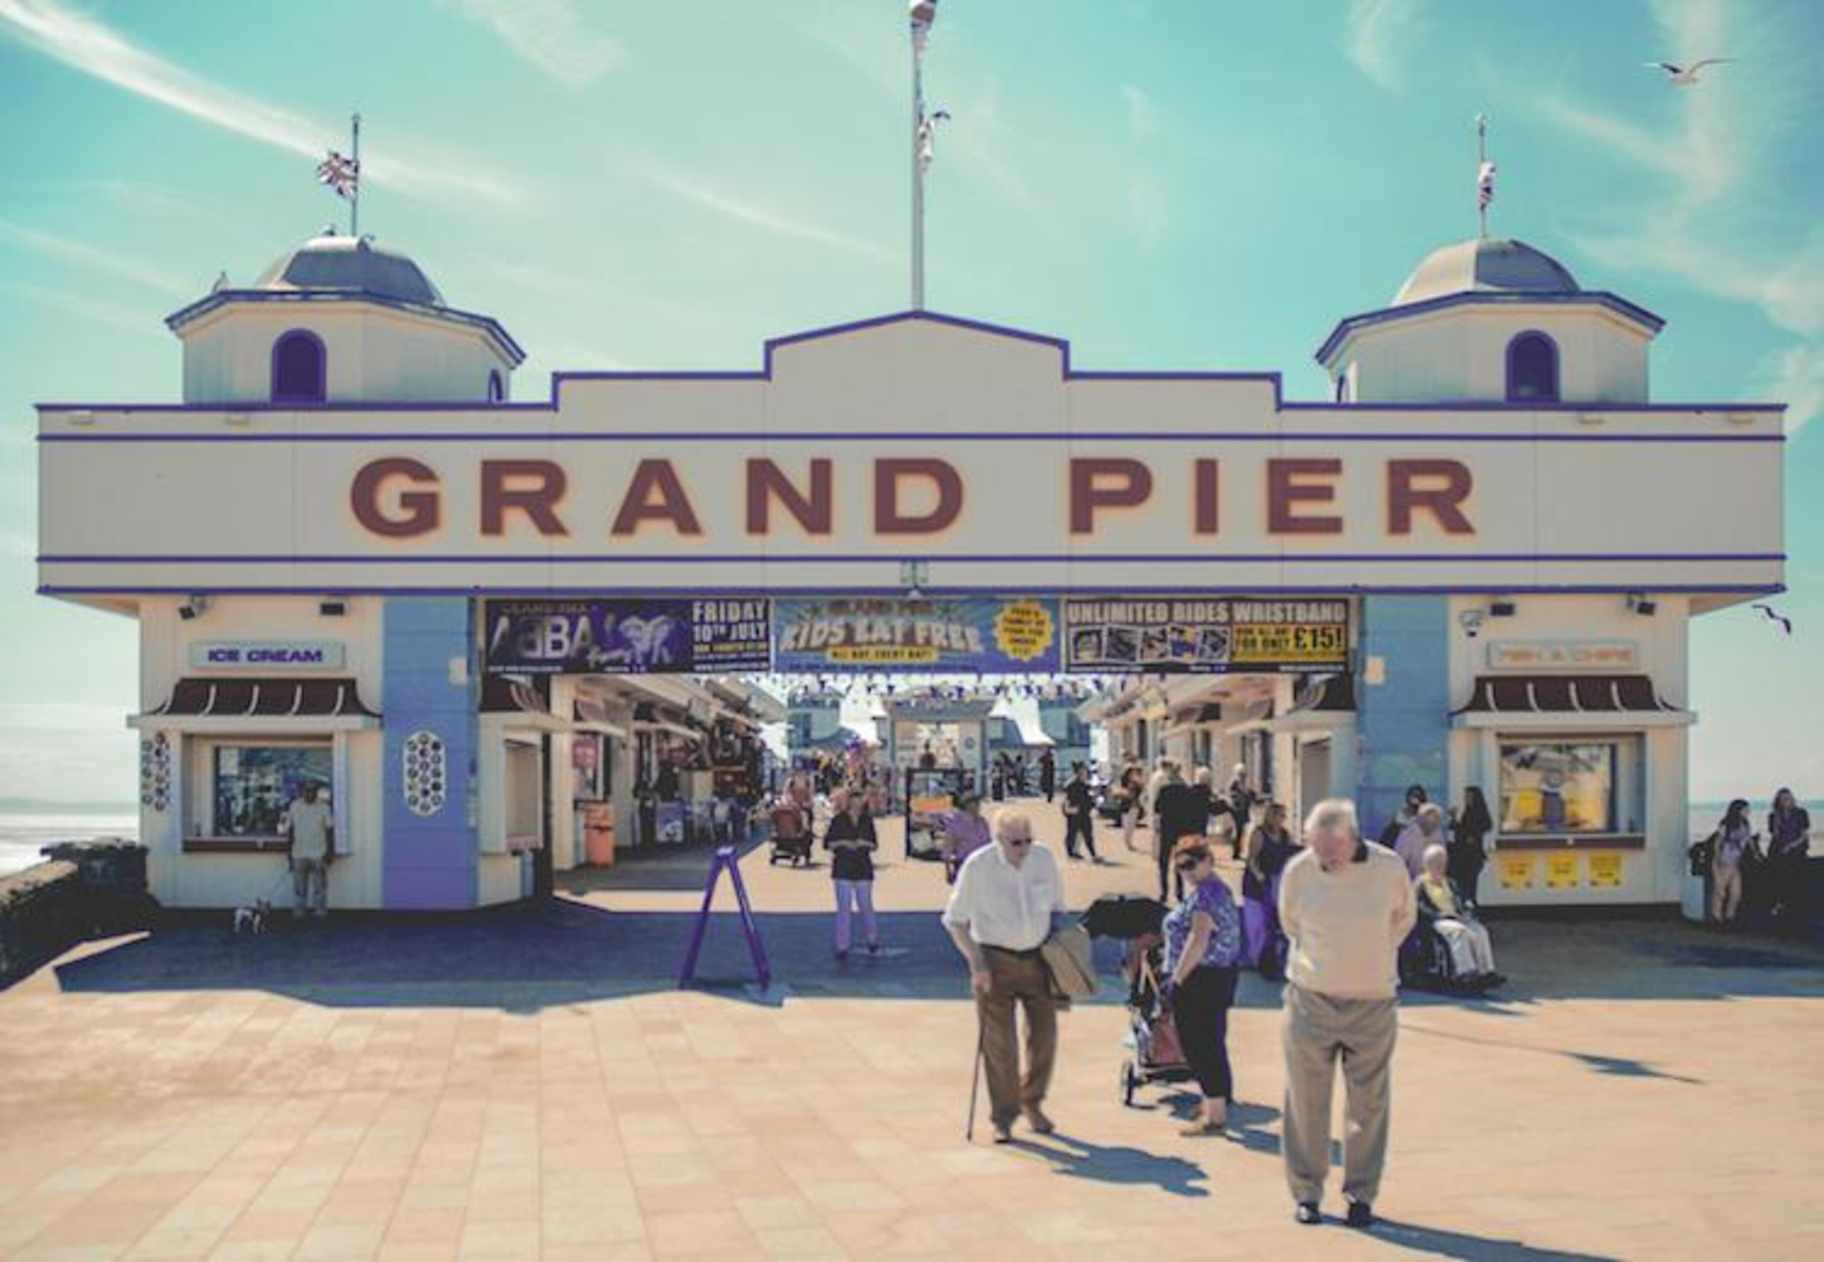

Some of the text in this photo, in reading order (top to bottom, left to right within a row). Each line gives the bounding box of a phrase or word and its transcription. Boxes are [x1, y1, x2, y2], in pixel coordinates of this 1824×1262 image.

[349, 456, 1477, 537] GRAND PIER
[692, 601, 766, 622] FRIDAY
[1067, 602, 1345, 622] UNLIMITED RIDES WRISTBAND
[488, 615, 593, 658] ABBA
[729, 621, 767, 641] JULY
[780, 617, 847, 651] KIDS
[854, 614, 907, 644] EAT
[913, 620, 984, 653] FREE
[1294, 626, 1342, 648] £15!
[208, 650, 323, 662] ICE CREAM
